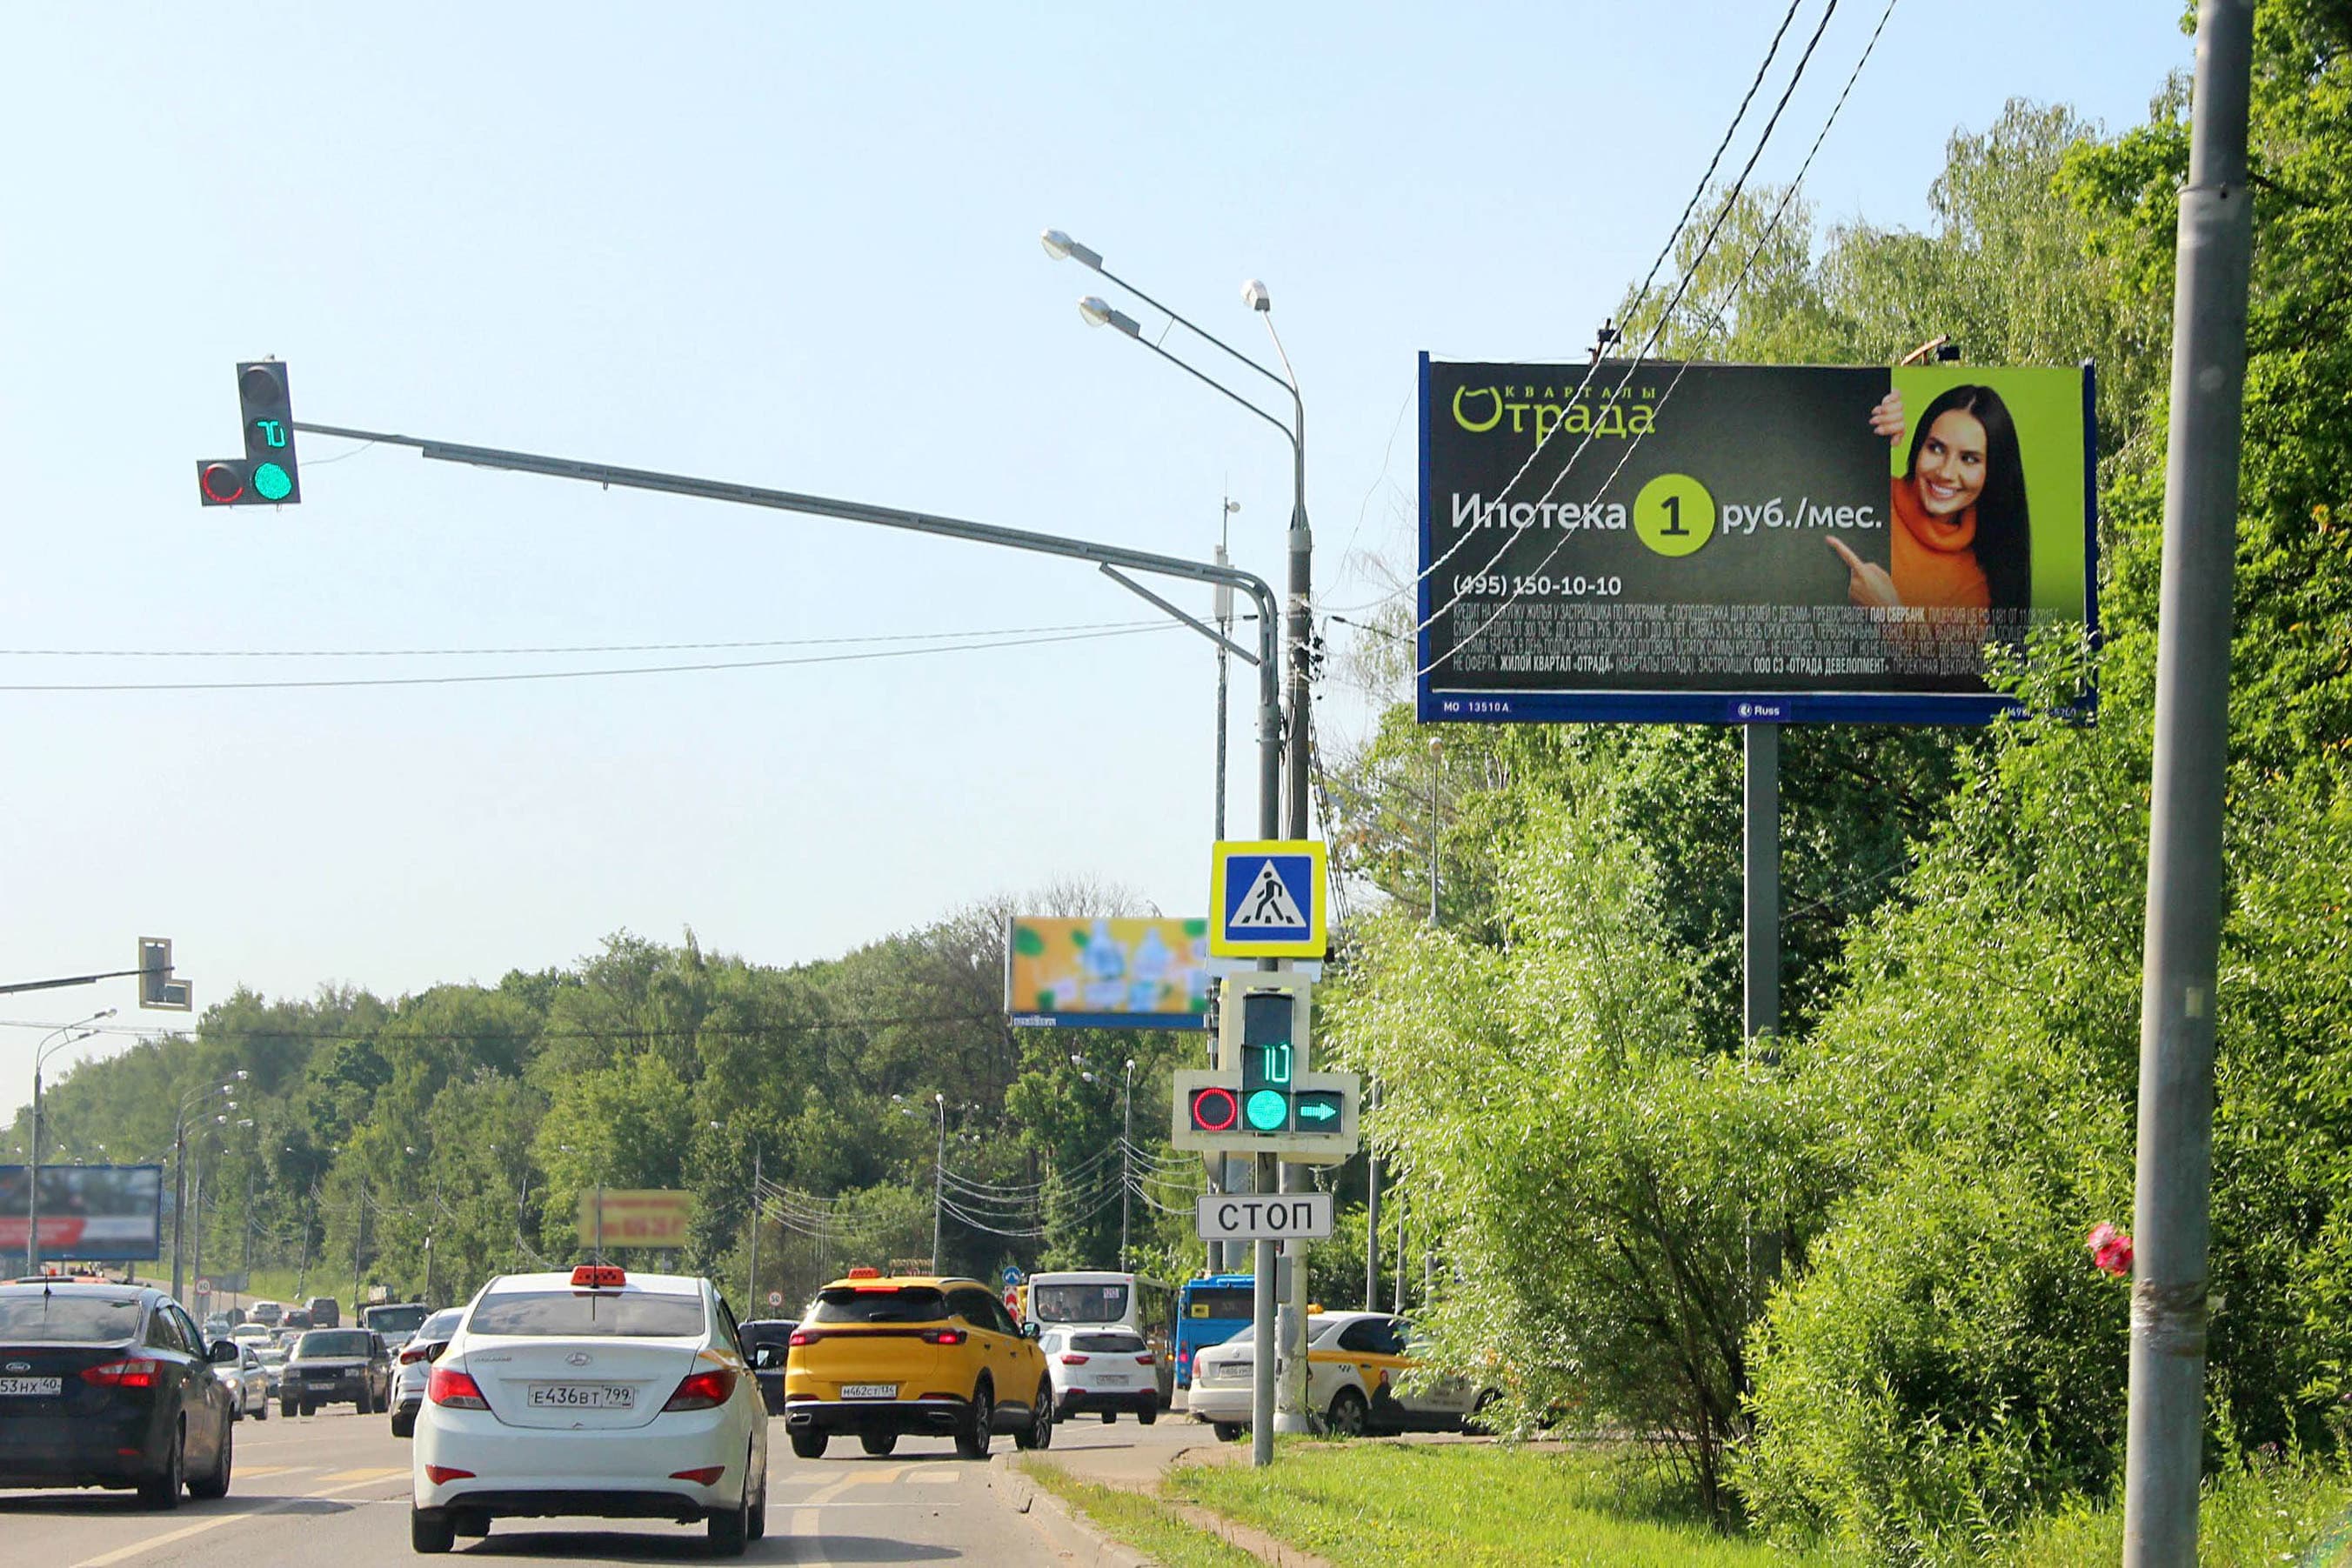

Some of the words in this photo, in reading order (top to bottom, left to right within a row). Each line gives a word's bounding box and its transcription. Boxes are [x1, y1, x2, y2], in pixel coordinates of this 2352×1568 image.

[1505, 385, 1656, 398] КВАРТАЛЫ
[1453, 384, 1656, 449] Отрада
[1451, 492, 1627, 530] Ипотека
[1660, 496, 1690, 536] 1
[1722, 497, 1882, 535] руб./мес.
[1453, 574, 1507, 596] (495)
[1513, 576, 1621, 596] 150-10-10
[1481, 604, 1491, 620] НА
[1527, 604, 1552, 620] ЖИЛЬЯ
[1614, 604, 1622, 621] ПО
[1870, 607, 1885, 623] ПАО
[1513, 621, 1522, 637] ОТ
[1555, 621, 1567, 639] ДО
[1568, 621, 1576, 637] 12
[1614, 622, 1633, 638] СРОК
[1634, 622, 1642, 638] ОТ
[1650, 622, 1661, 640] ДО
[1734, 623, 1743, 639] НА
[1907, 624, 1916, 640] ОТ
[1453, 655, 1463, 671] НЕ
[1500, 653, 1531, 671] ЖИЛОЙ
[1533, 656, 1571, 672] КВАРТАЛ
[1698, 655, 1752, 676] ЗАСТРОЙЩИК
[1754, 657, 1771, 674] ООО
[1773, 657, 1783, 674] СЗ
[1443, 702, 1460, 712] МО
[1754, 705, 1780, 716] Russ
[1218, 1203, 1312, 1231] СТОП
[43, 1379, 57, 1389] 40
[534, 1388, 599, 1405] Е436ВТ
[604, 1388, 631, 1400] 799
